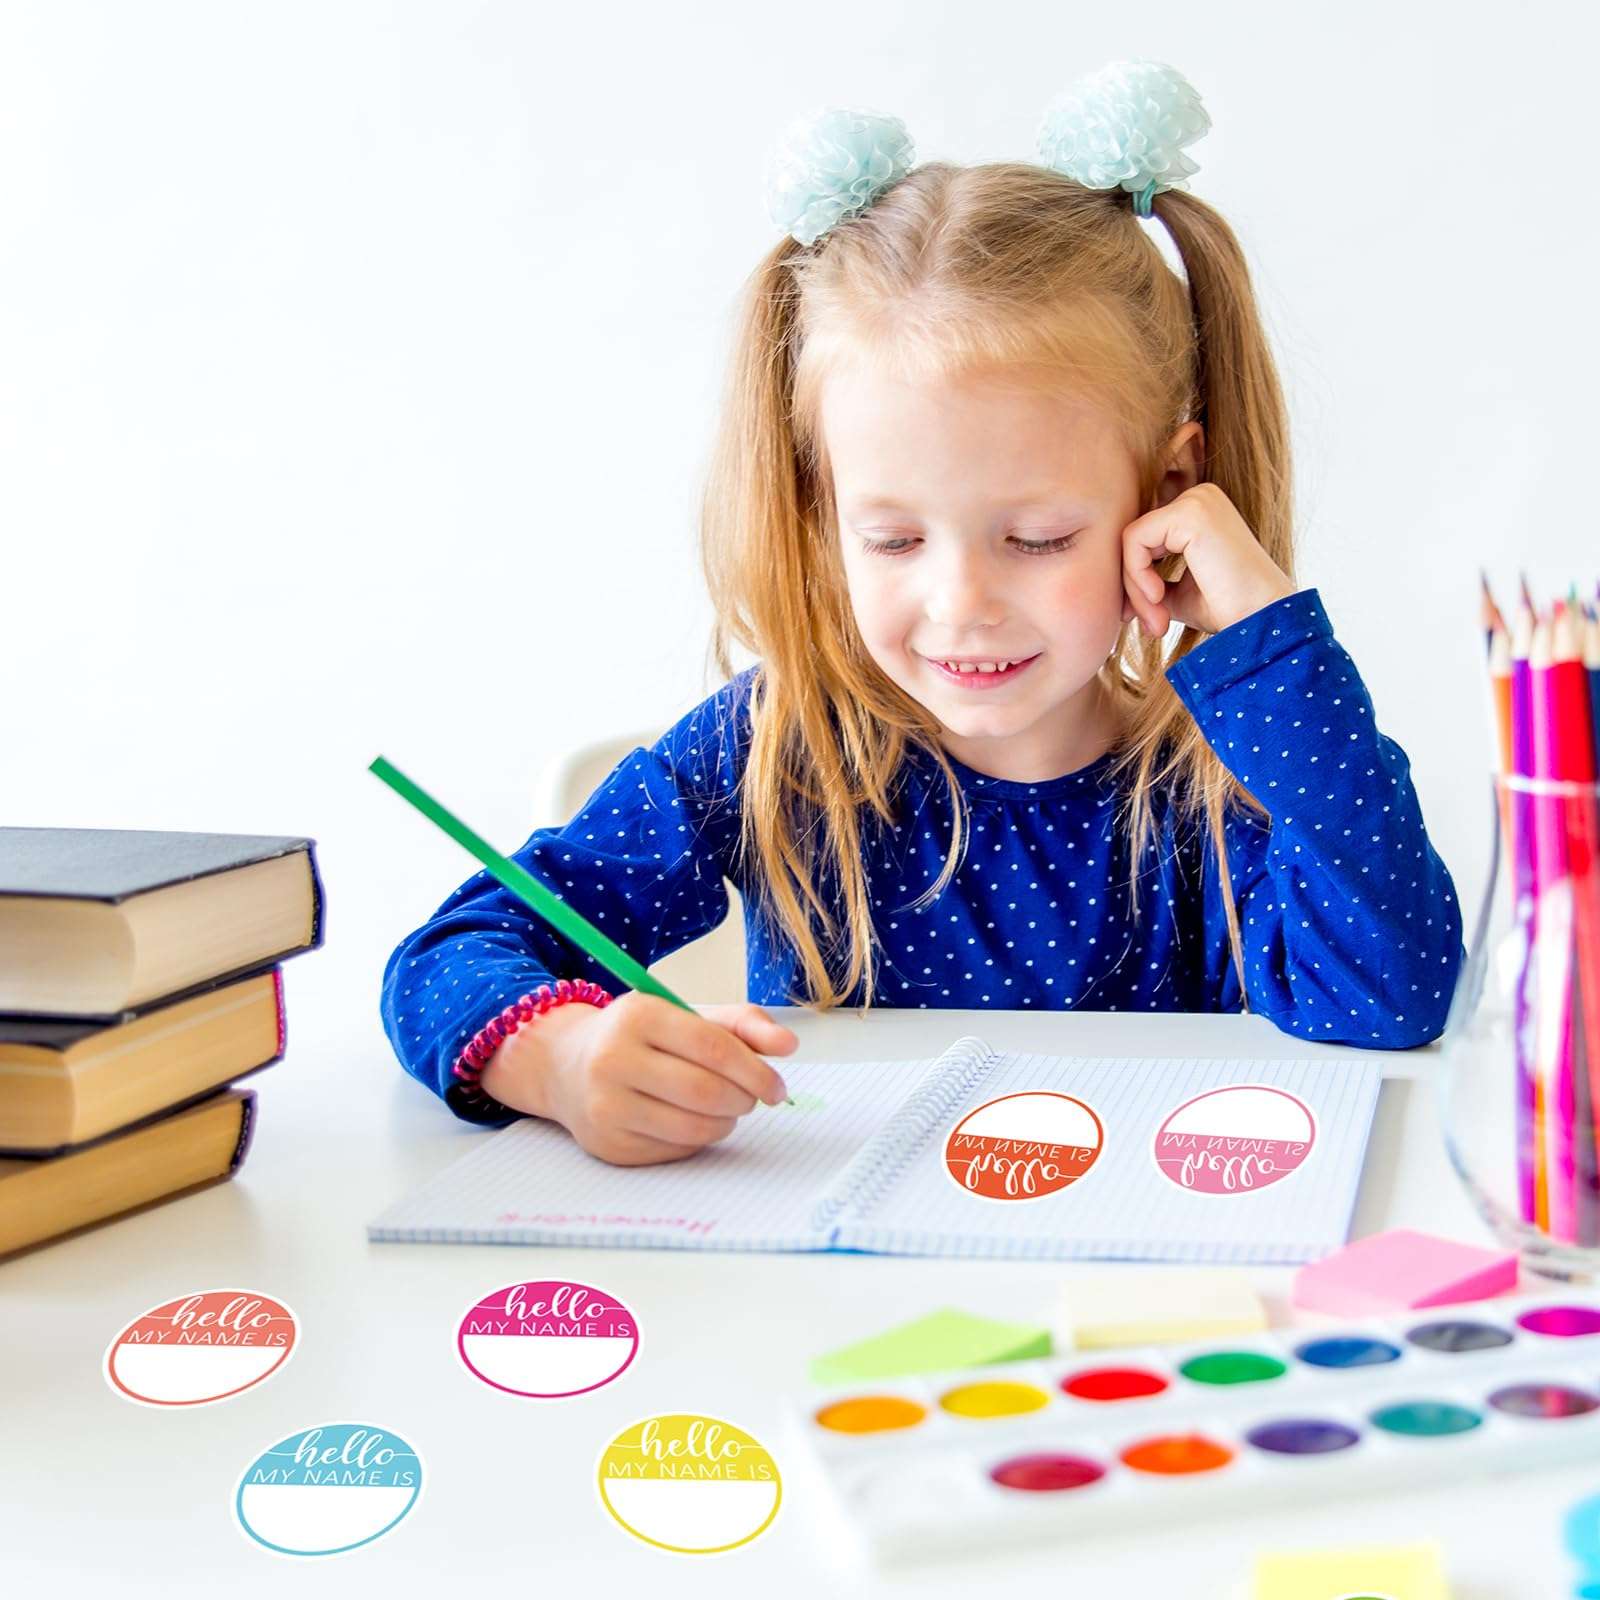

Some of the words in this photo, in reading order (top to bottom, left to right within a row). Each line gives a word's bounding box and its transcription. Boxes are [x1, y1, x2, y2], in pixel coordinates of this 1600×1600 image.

[171, 1295, 273, 1331] hello
[505, 1285, 606, 1321] hello
[128, 1330, 170, 1343] MY
[178, 1331, 258, 1345] NAME
[265, 1332, 288, 1346] IS
[469, 1321, 509, 1334] MY
[520, 1322, 598, 1336] NAME
[610, 1323, 630, 1337] IS
[293, 1429, 396, 1468] hello
[640, 1419, 743, 1462] hello
[252, 1469, 296, 1483] MY
[303, 1470, 383, 1485] NAME
[393, 1471, 414, 1486] IS
[608, 1462, 649, 1477] MY
[660, 1463, 737, 1479] NAME
[750, 1464, 772, 1480] IS
